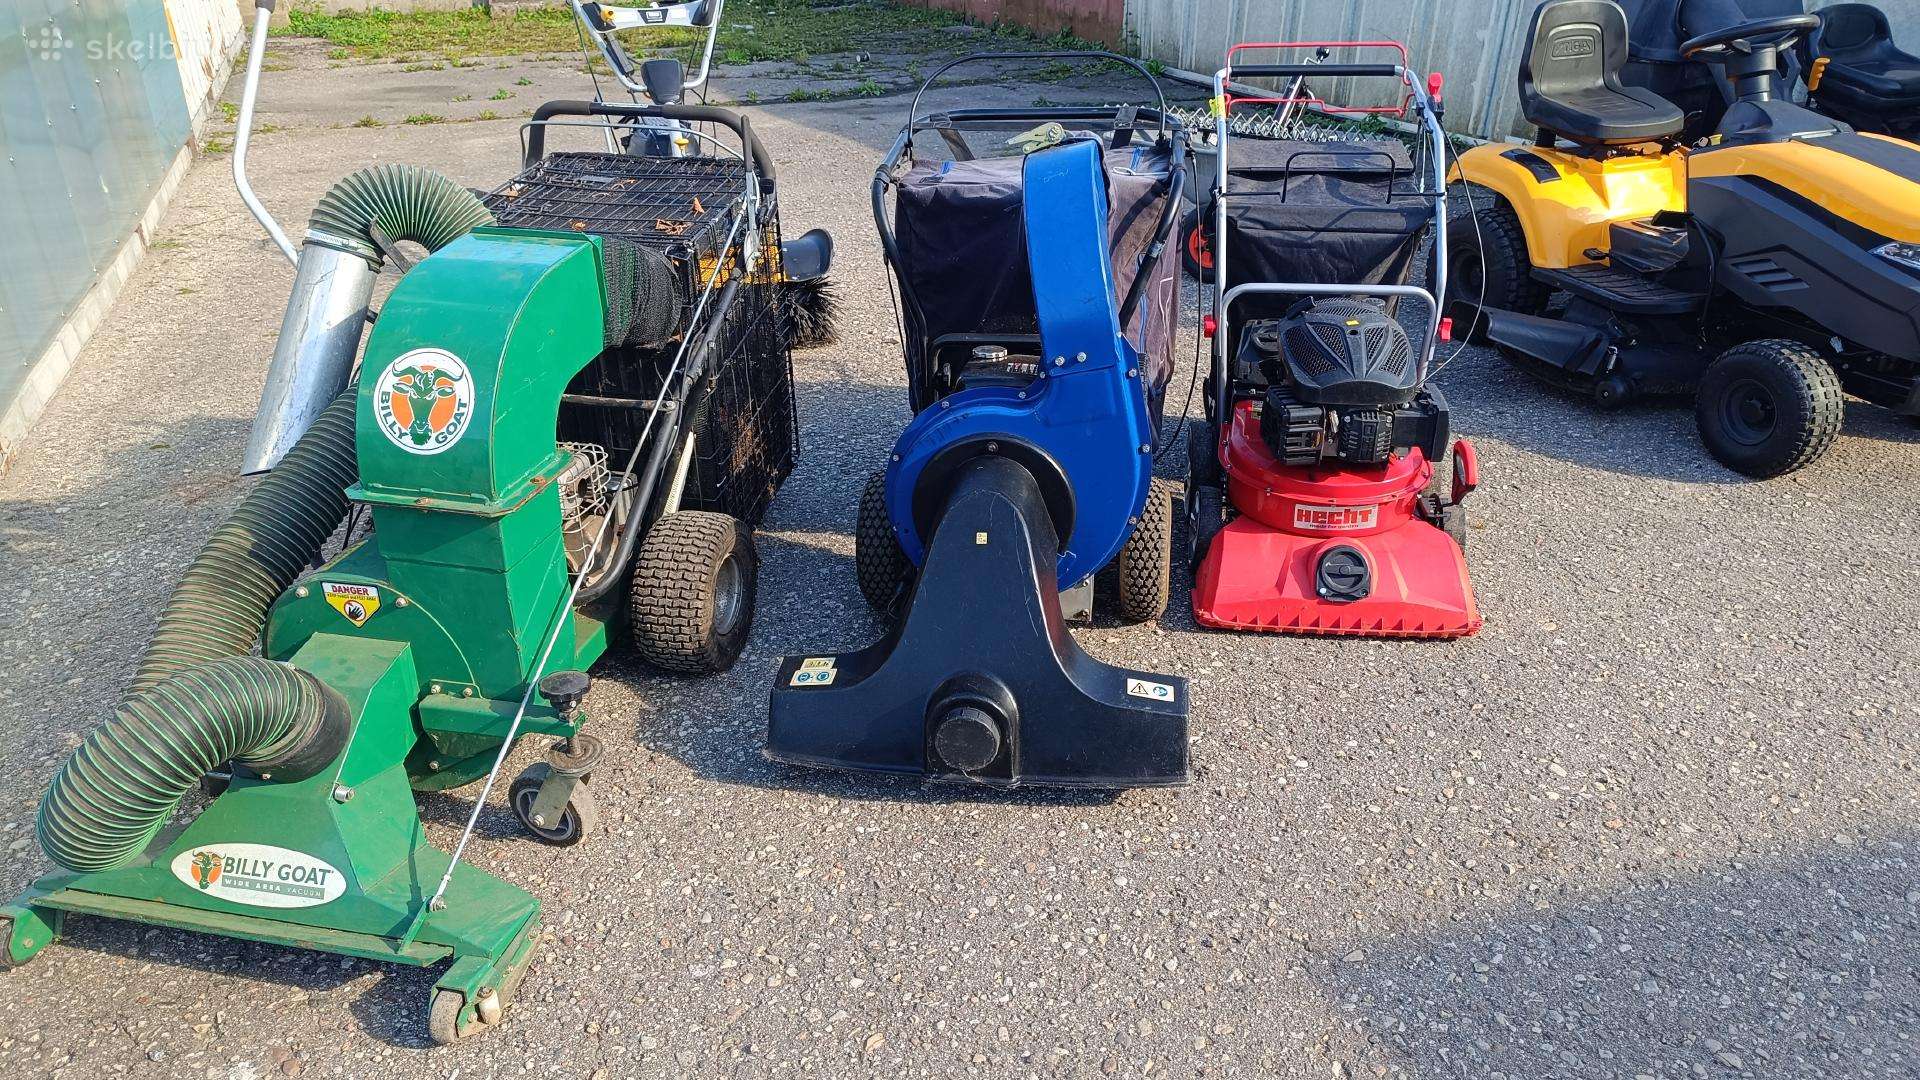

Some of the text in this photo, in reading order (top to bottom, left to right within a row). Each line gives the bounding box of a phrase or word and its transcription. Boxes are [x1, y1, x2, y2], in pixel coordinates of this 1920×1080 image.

[380, 390, 467, 444] BILLY GOAT
[332, 585, 369, 596] DANGER
[223, 856, 332, 886] BILLY GOAT
